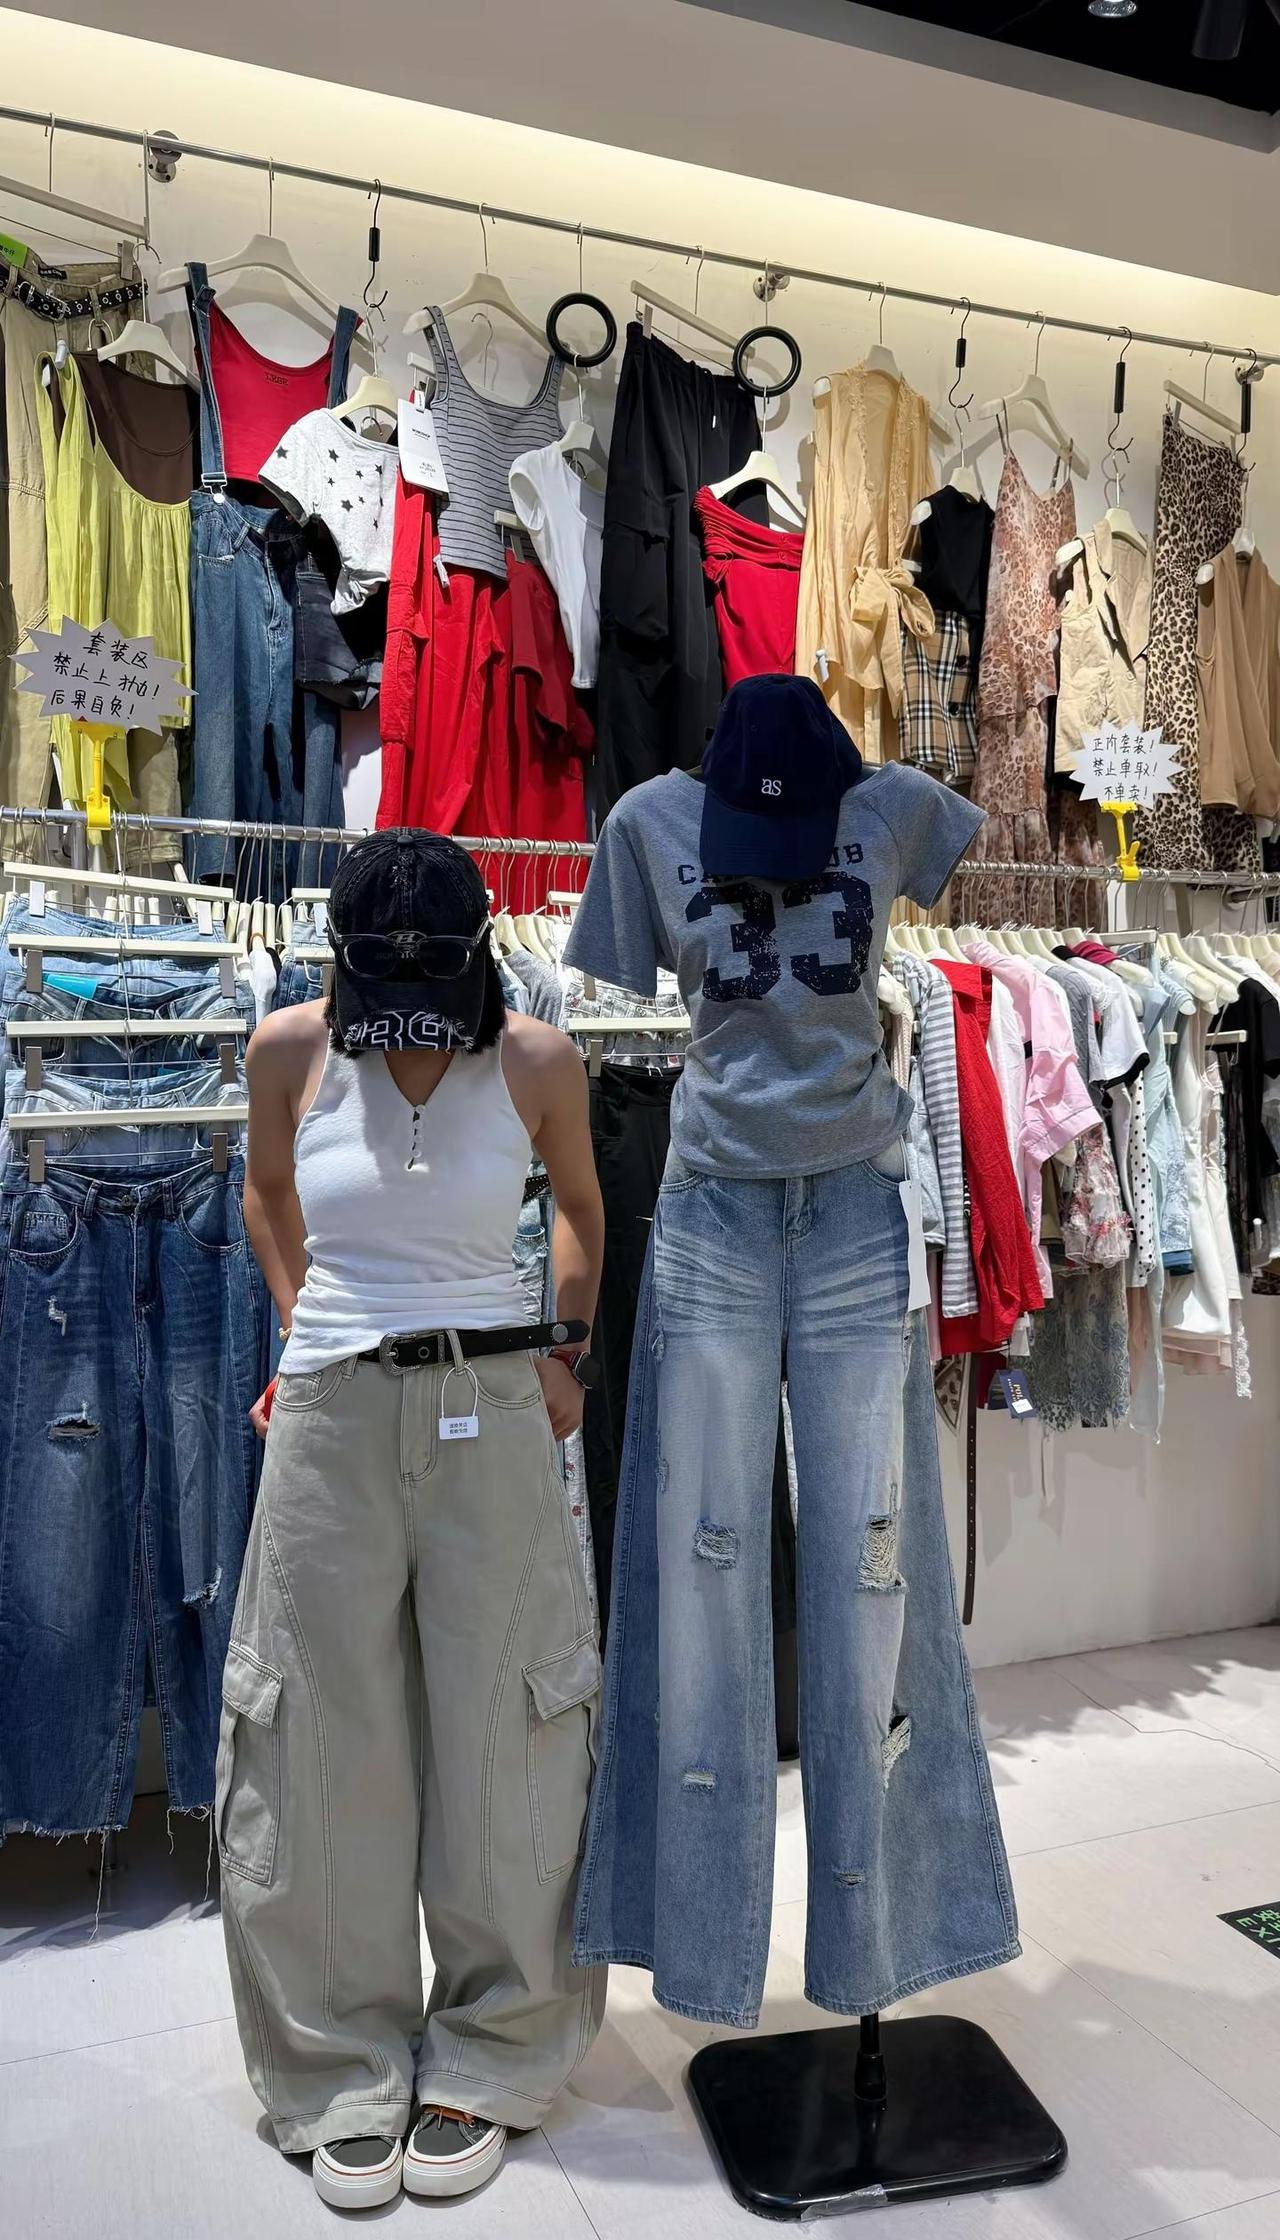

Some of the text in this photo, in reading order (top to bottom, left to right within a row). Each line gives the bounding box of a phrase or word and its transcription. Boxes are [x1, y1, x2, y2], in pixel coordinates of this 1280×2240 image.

[83, 632, 149, 669] 套装区
[50, 689, 135, 720] 后果自负!
[761, 778, 782, 796] as
[1104, 782, 1148, 802] 不单卖!
[685, 872, 874, 1002] 33
